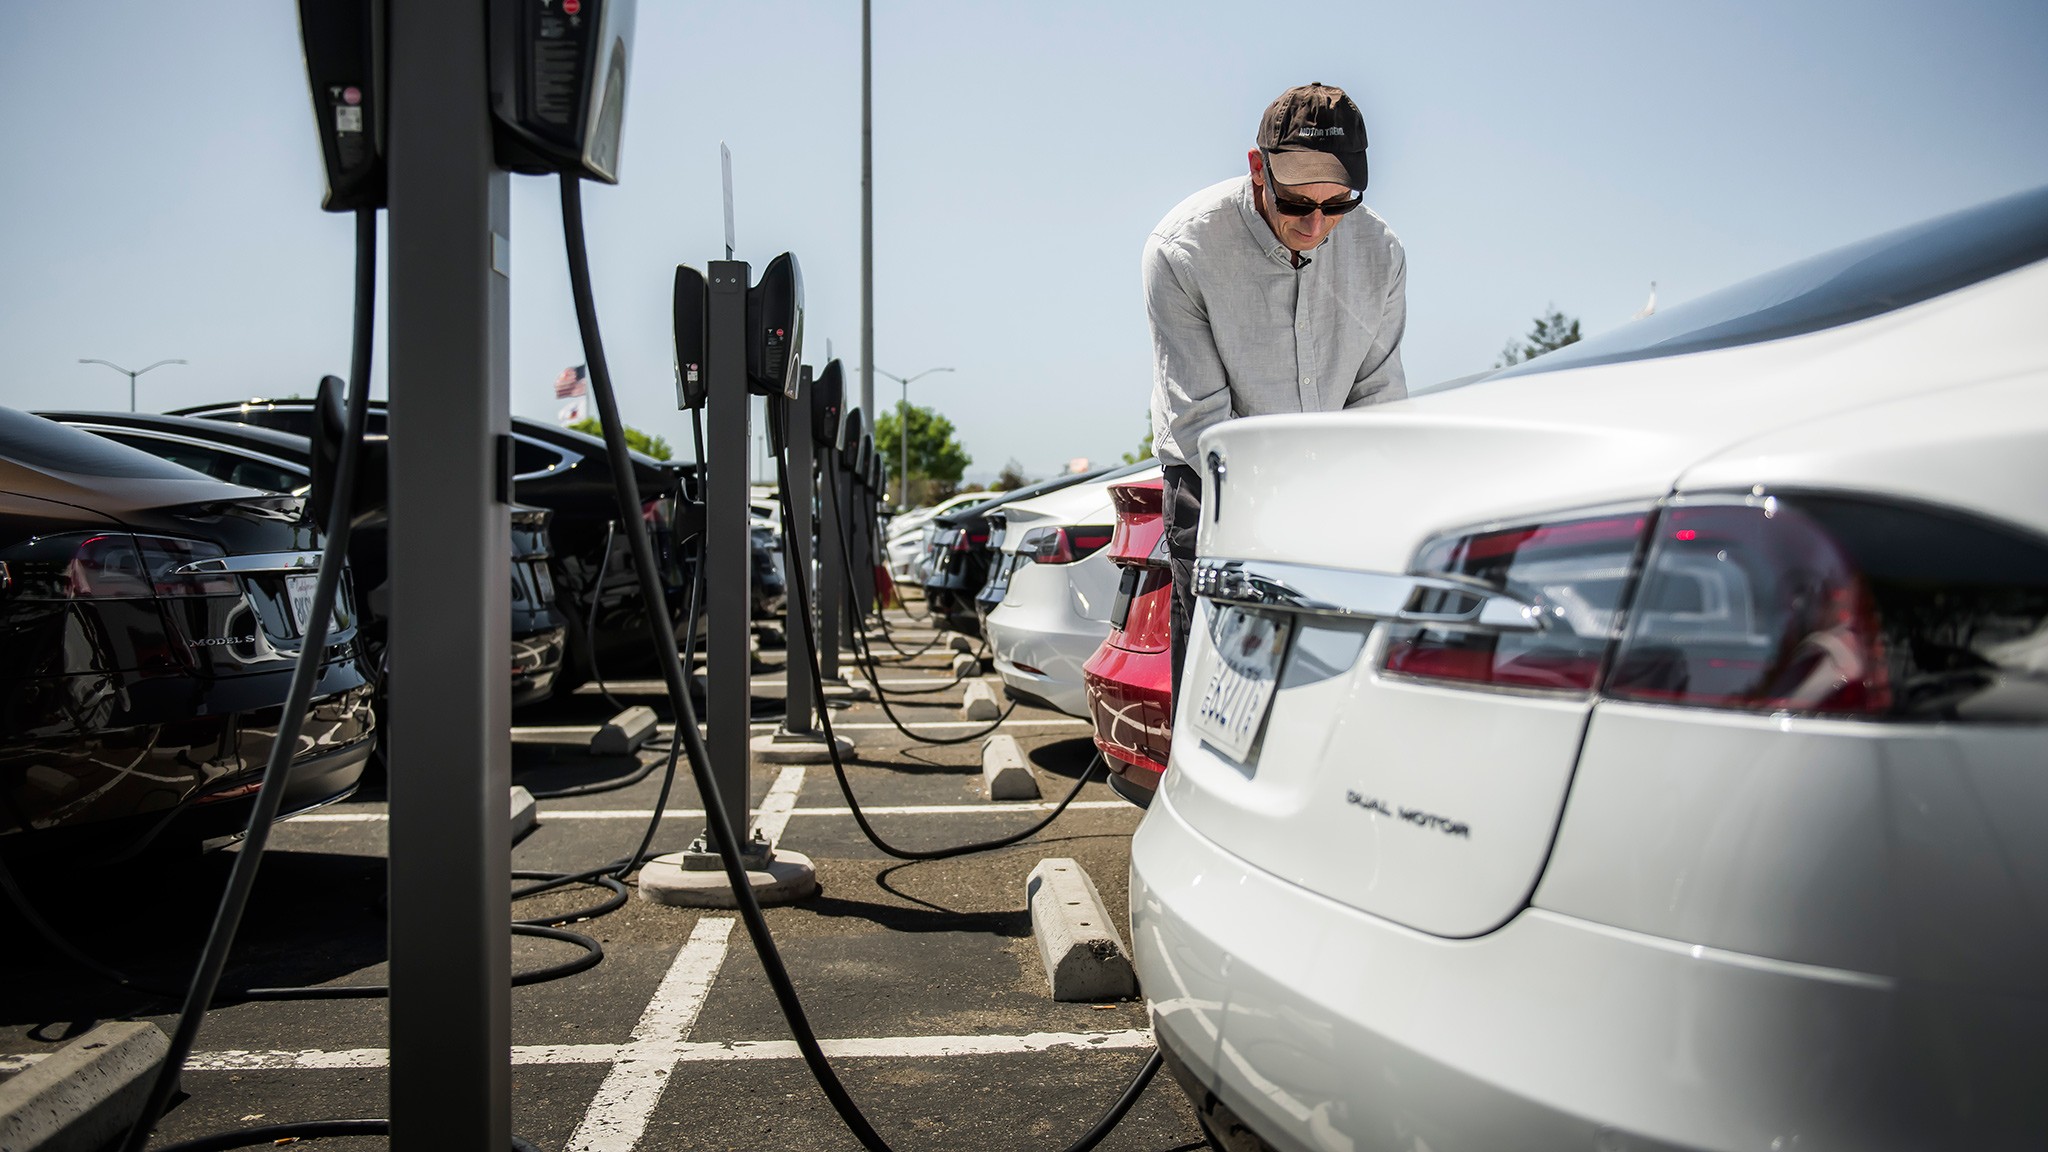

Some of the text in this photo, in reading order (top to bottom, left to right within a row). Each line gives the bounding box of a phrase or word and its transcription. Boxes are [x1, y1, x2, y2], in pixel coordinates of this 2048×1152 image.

[189, 634, 256, 648] MODEL S
[1347, 790, 1471, 839] DUAL MOTOR
